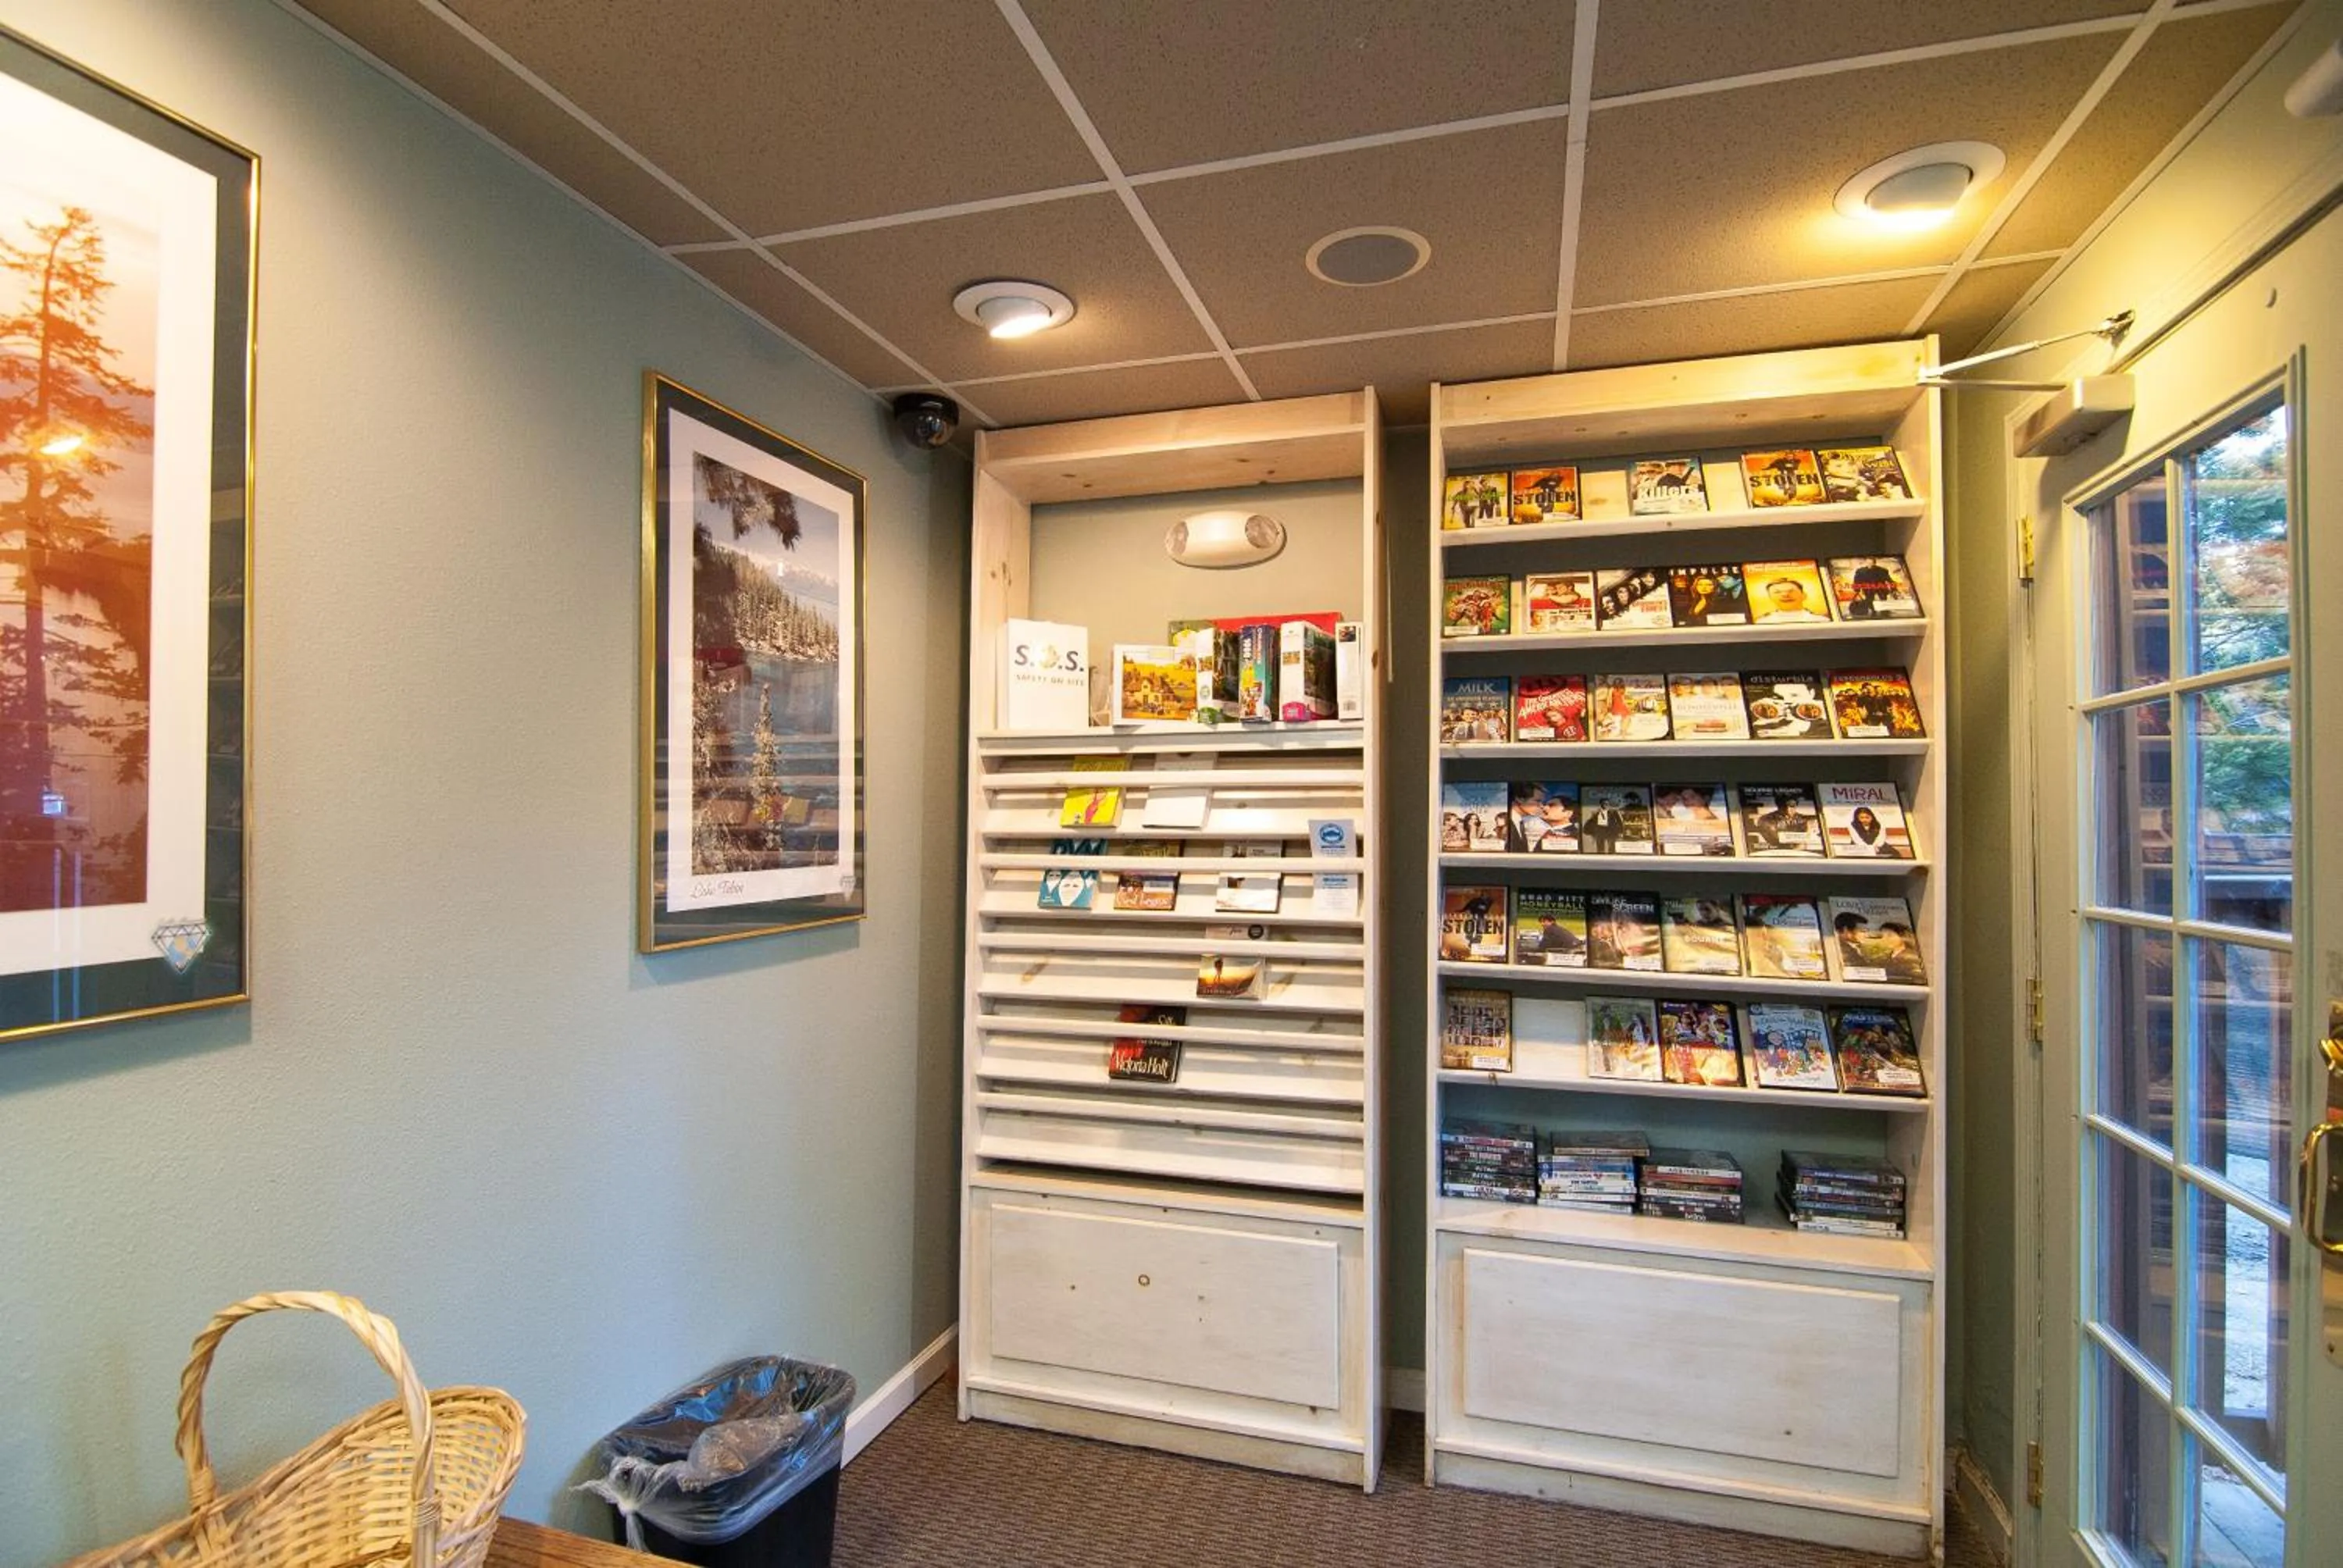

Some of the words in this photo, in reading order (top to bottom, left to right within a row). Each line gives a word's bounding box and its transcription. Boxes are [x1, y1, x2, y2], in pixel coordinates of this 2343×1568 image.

[1749, 473, 1820, 488] STOLEN
[1514, 490, 1576, 505] STOLEN
[1668, 565, 1739, 576] IMPULSE
[1456, 682, 1496, 694] MILK
[1832, 786, 1884, 800] MIRAL
[1443, 919, 1504, 935] STOLEN
